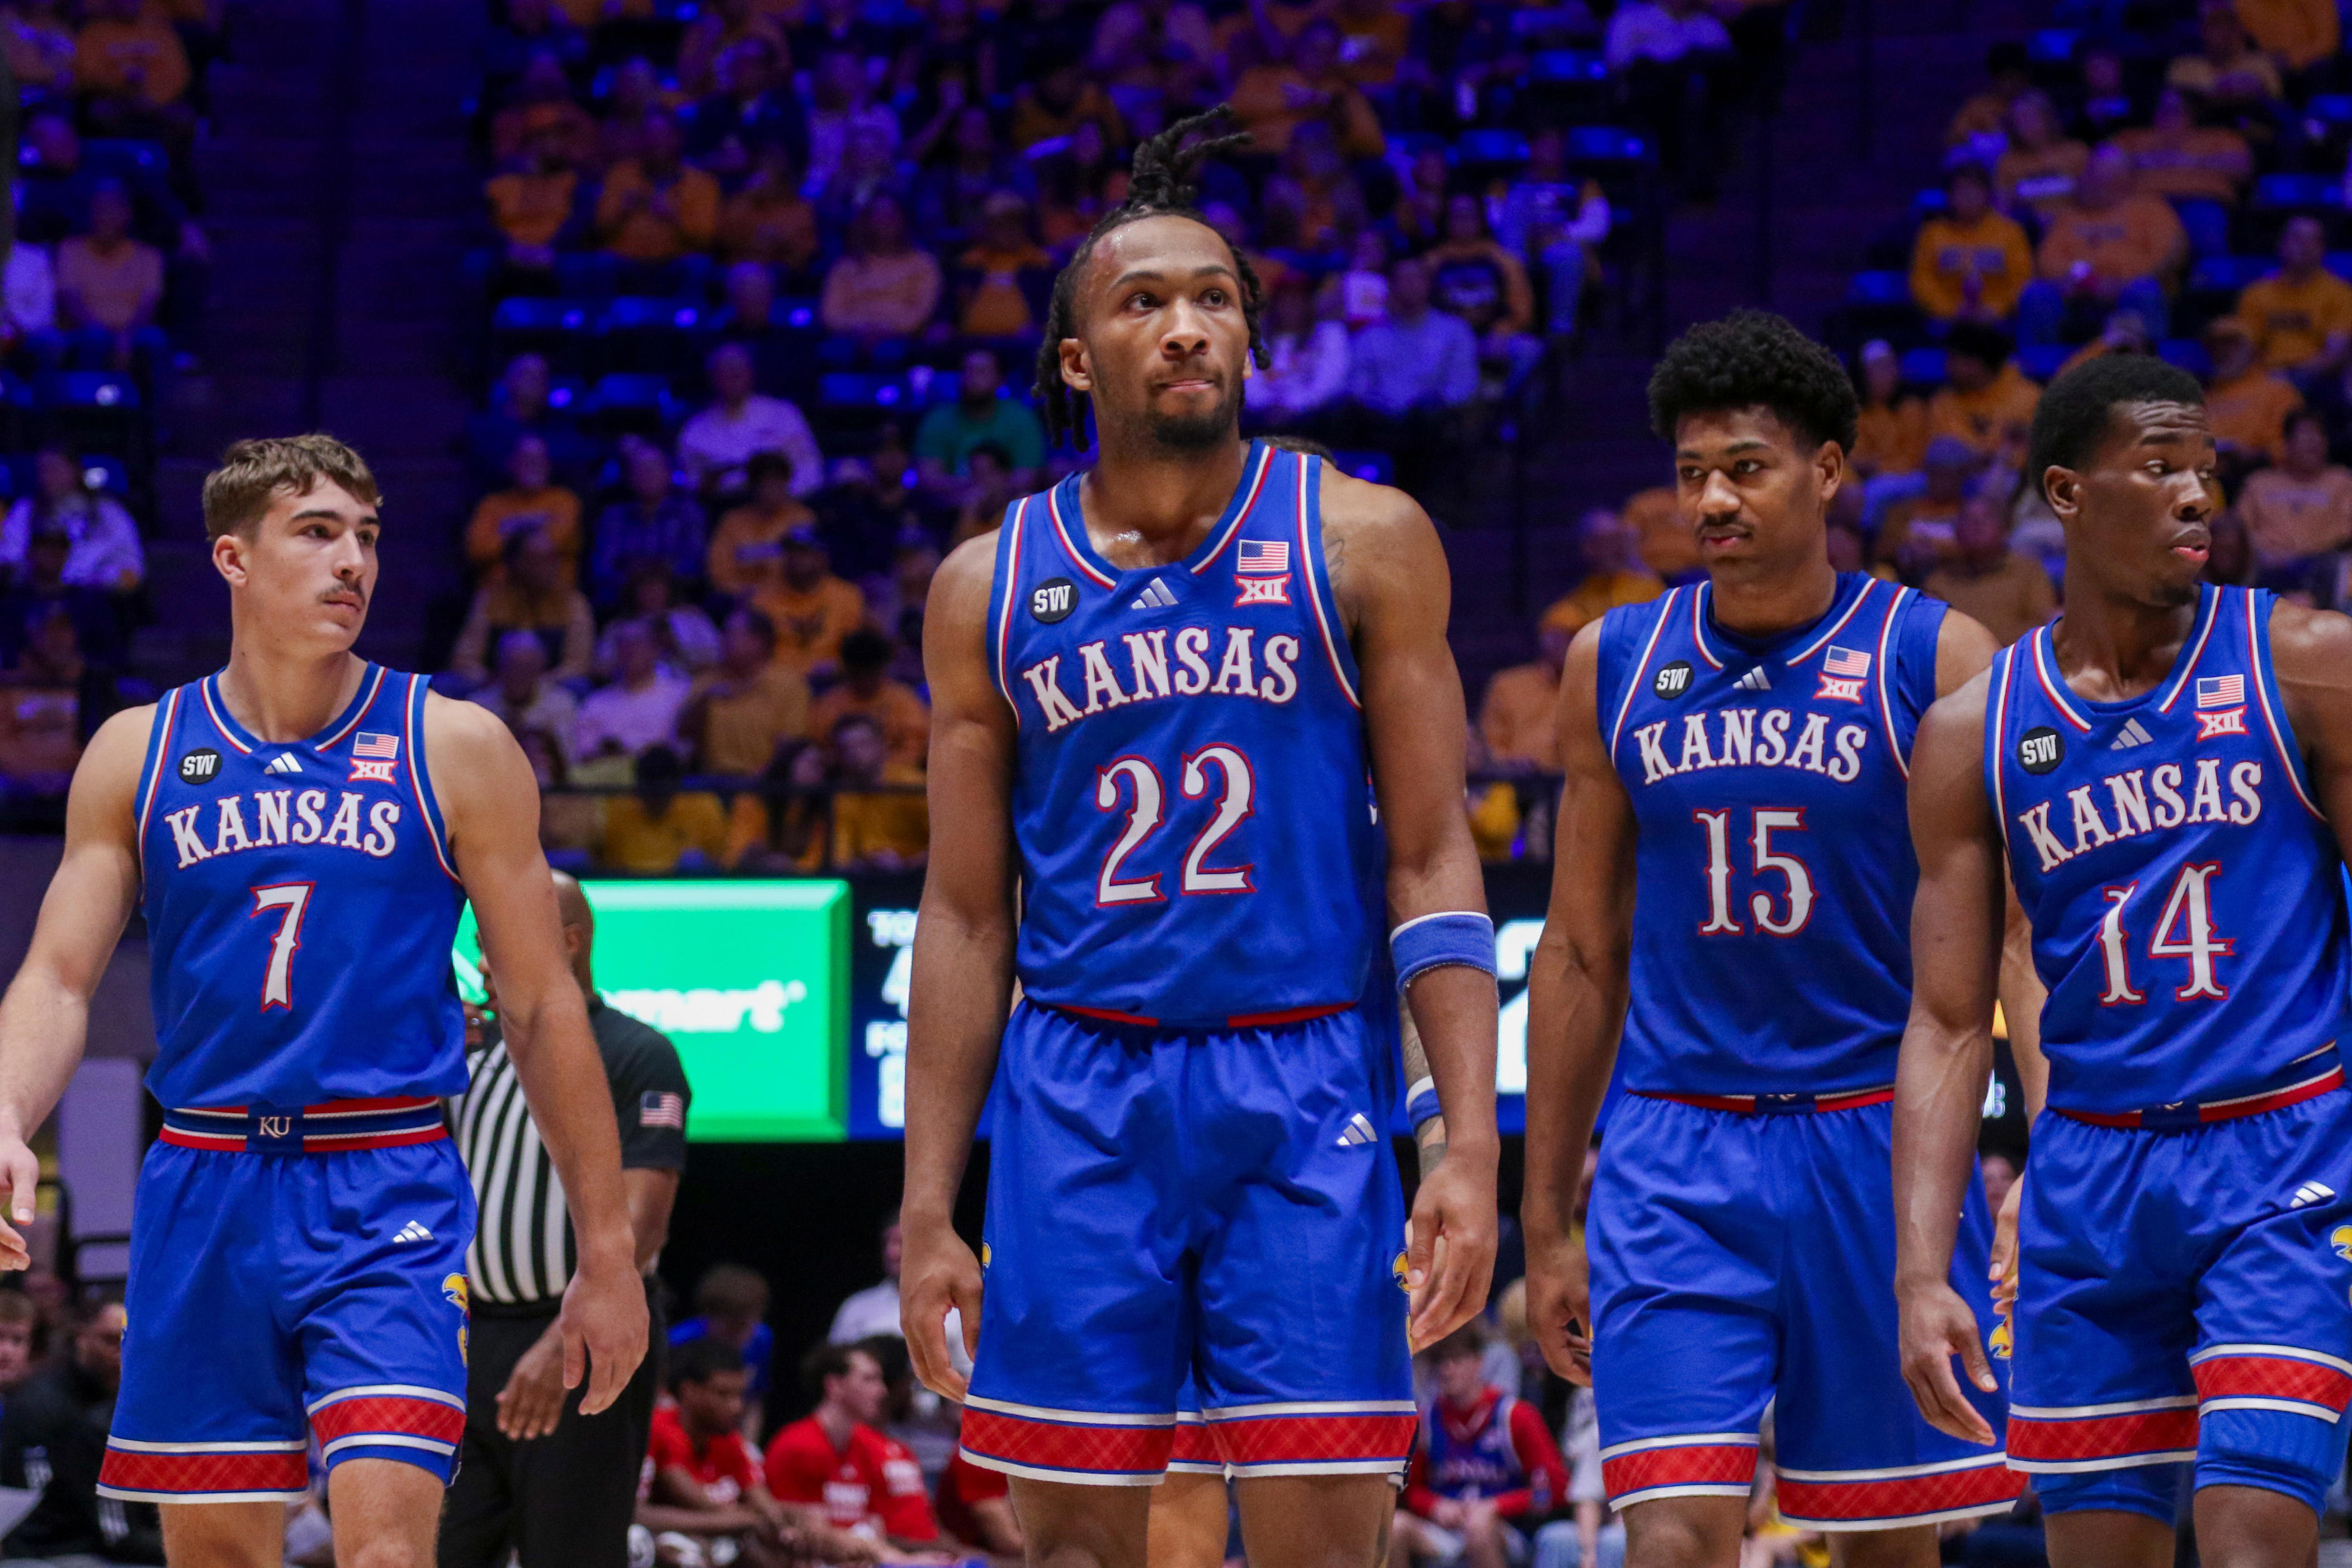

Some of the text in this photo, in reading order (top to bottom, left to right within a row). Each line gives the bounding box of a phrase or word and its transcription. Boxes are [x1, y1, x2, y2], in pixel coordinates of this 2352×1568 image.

[1033, 585, 1071, 613] SW
[1023, 627, 1299, 733] KANSAS
[1656, 667, 1689, 691] SW
[182, 754, 217, 776] SW
[1633, 709, 1867, 785] KANSAS
[2022, 734, 2057, 765] SW
[164, 789, 401, 869] KANSAS
[1094, 742, 1257, 909] 22
[2019, 758, 2263, 872] KANSAS
[1693, 806, 1820, 936] 15
[249, 881, 316, 1013] 7
[2095, 861, 2237, 1006] 14
[259, 1116, 291, 1138] KU
